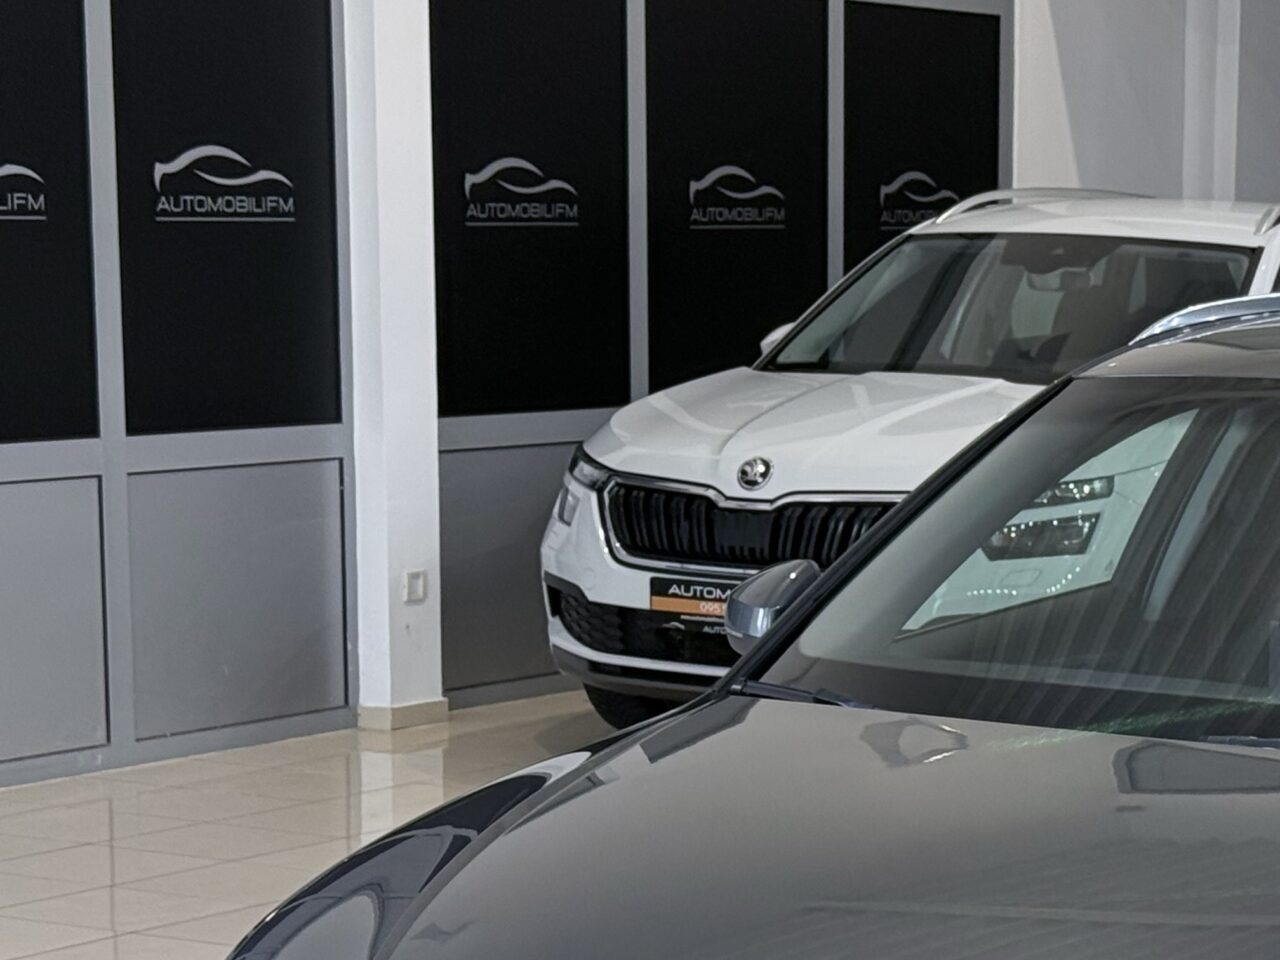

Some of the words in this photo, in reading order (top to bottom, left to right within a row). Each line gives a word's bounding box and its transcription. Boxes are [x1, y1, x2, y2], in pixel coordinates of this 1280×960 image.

[156, 195, 294, 213] AUTOMOBILIFM
[466, 203, 578, 218] AUTOMOBILIFM
[690, 207, 785, 222] AUTOMOBILIFM
